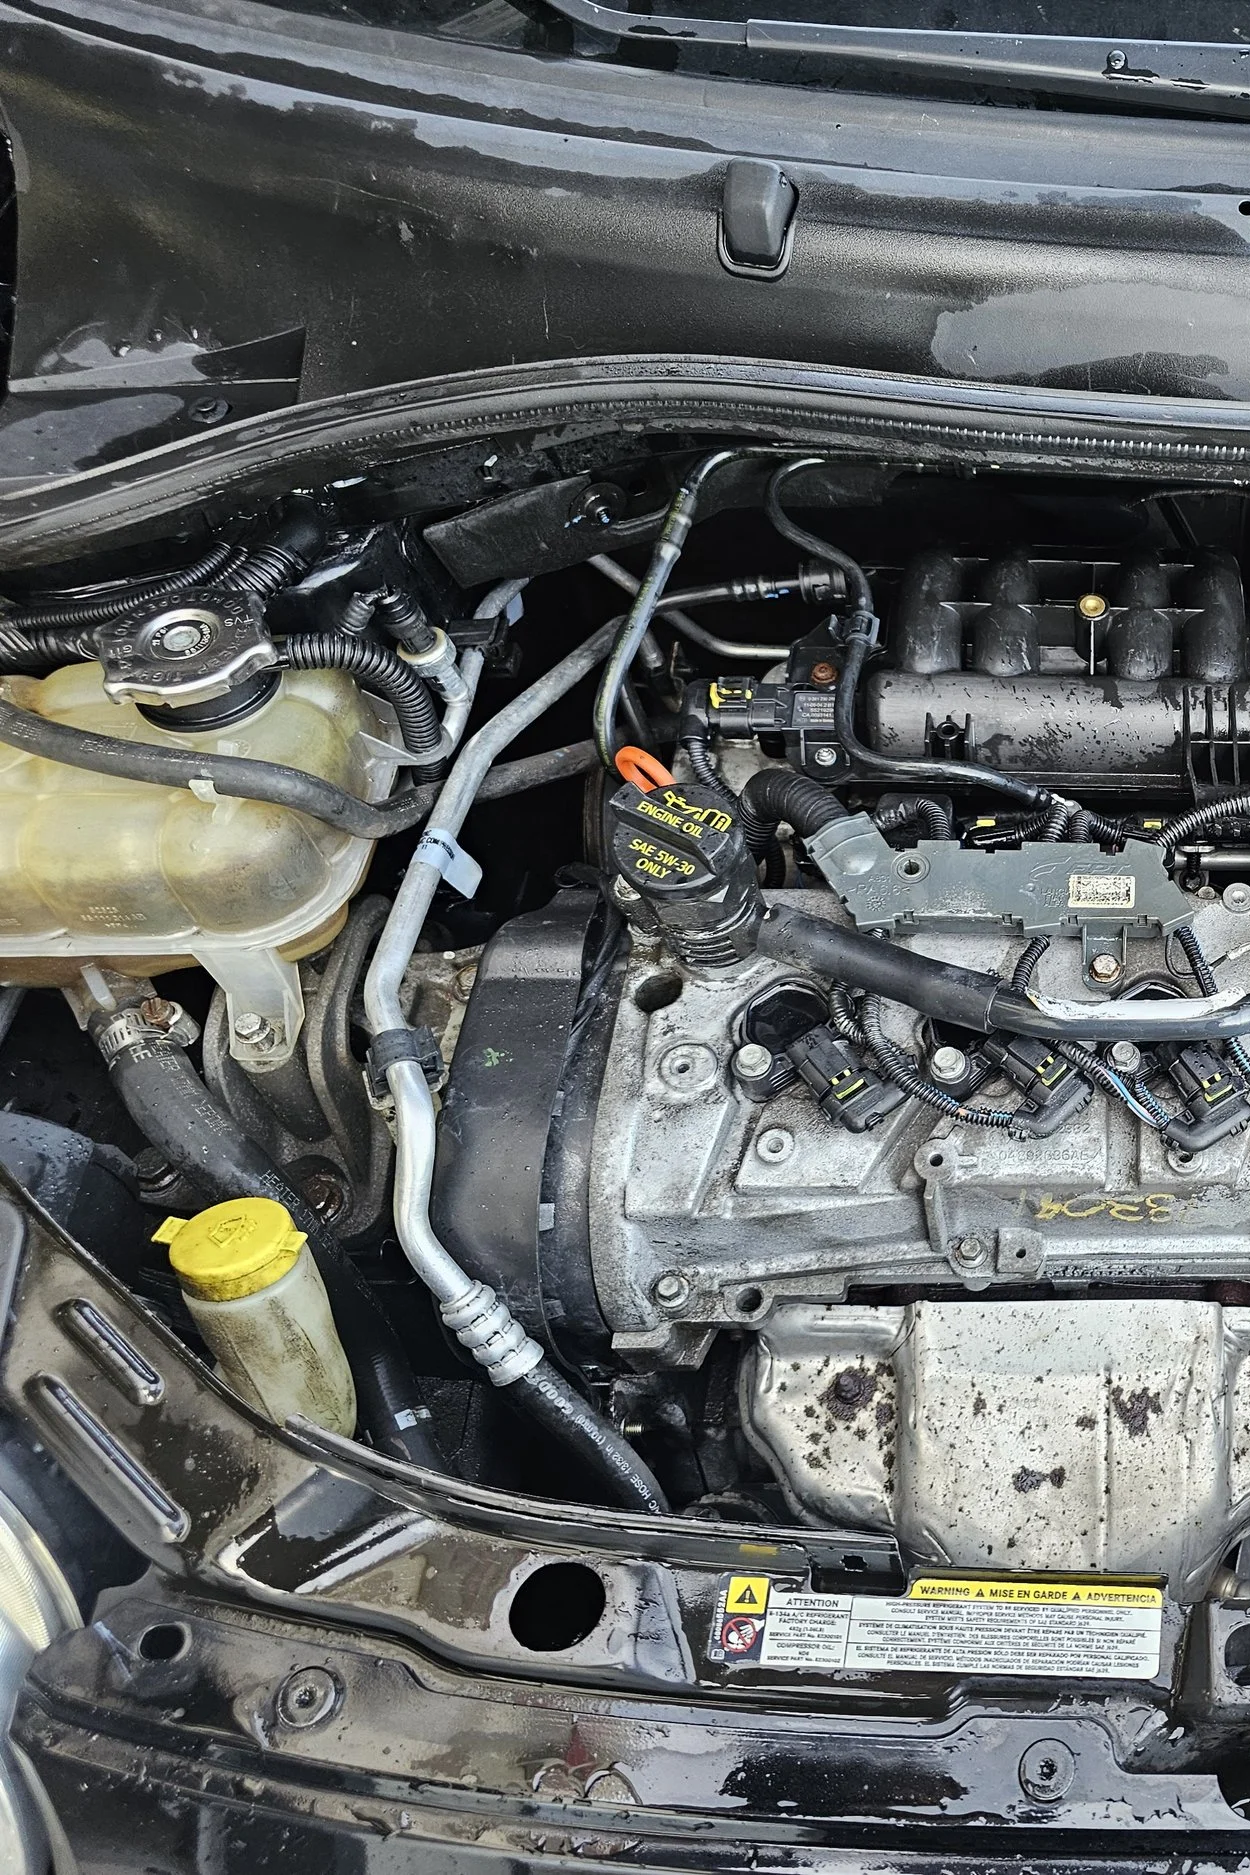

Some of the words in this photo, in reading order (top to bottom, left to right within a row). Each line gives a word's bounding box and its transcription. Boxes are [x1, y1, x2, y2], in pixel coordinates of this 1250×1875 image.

[224, 615, 254, 627] TVS
[636, 801, 684, 827] ENGINE
[682, 822, 704, 839] OIL
[629, 838, 655, 857] SAE
[656, 852, 696, 876] 5W-30
[635, 858, 671, 879] ONLY
[260, 1169, 301, 1209] HEATER
[605, 1444, 614, 1456] in
[611, 1451, 632, 1474] 13/32
[630, 1473, 652, 1500] HOSE
[786, 1598, 839, 1607] ATTENTION
[920, 1586, 970, 1597] WARNING
[990, 1588, 1014, 1598] MISE
[1017, 1590, 1030, 1598] EN
[1033, 1591, 1067, 1600] GARDE
[1087, 1593, 1156, 1603] ADVERTENCIA
